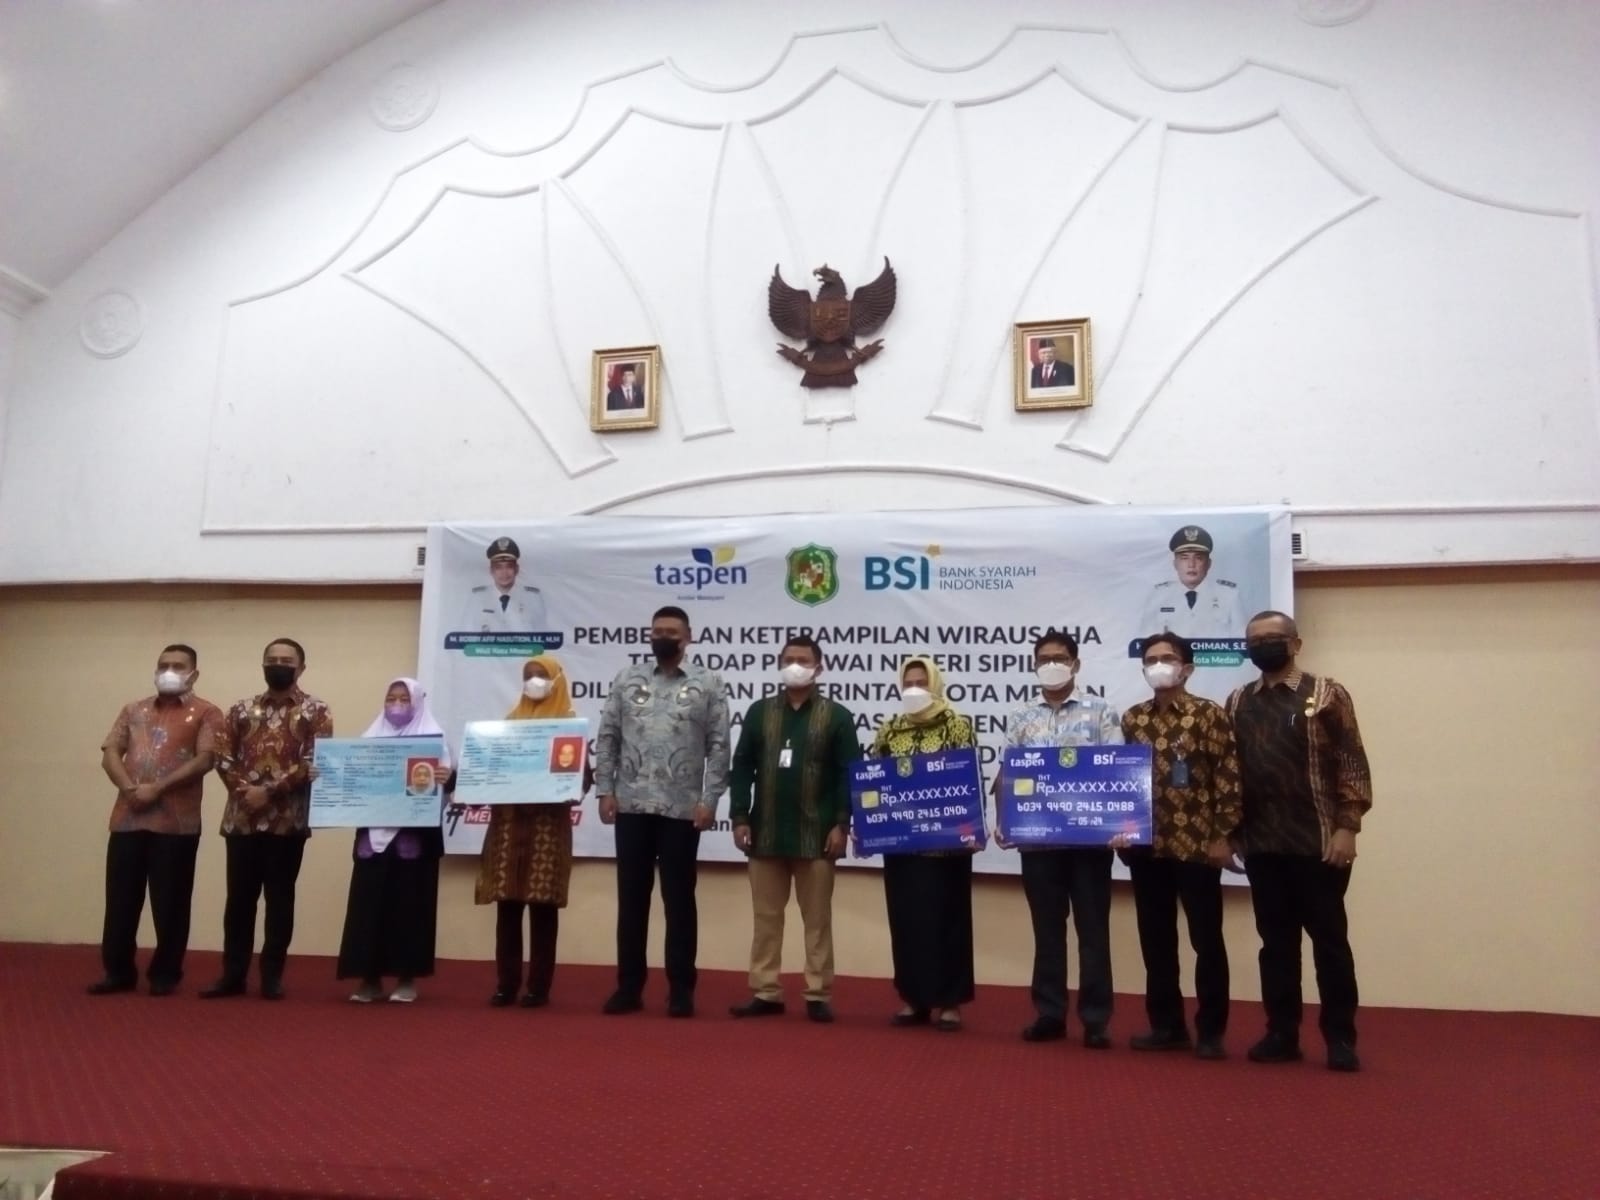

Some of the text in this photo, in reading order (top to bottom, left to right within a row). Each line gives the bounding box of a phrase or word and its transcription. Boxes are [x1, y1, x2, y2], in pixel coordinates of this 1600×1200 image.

[655, 564, 747, 590] taspen
[865, 556, 930, 590] BSI
[939, 566, 1036, 577] BANK SYARIAH
[939, 579, 1014, 590] INDONESIA
[574, 626, 733, 644] PEMBEAN
[740, 626, 929, 644] KETERAMPILAN
[1190, 641, 1231, 651] CHMAN,
[628, 653, 1036, 672] TADAP PWAI NERI SIPIL
[1212, 654, 1239, 664] Medan
[943, 684, 999, 702] OTA
[1006, 684, 1105, 702] MEN
[1010, 758, 1045, 768] taspen
[1093, 753, 1114, 765] BSI
[856, 769, 886, 781] taspen
[926, 760, 945, 772] BSI
[892, 811, 914, 820] 9490
[917, 808, 940, 818] 2415
[1017, 801, 1135, 812] 6034 9490 2415 0488
